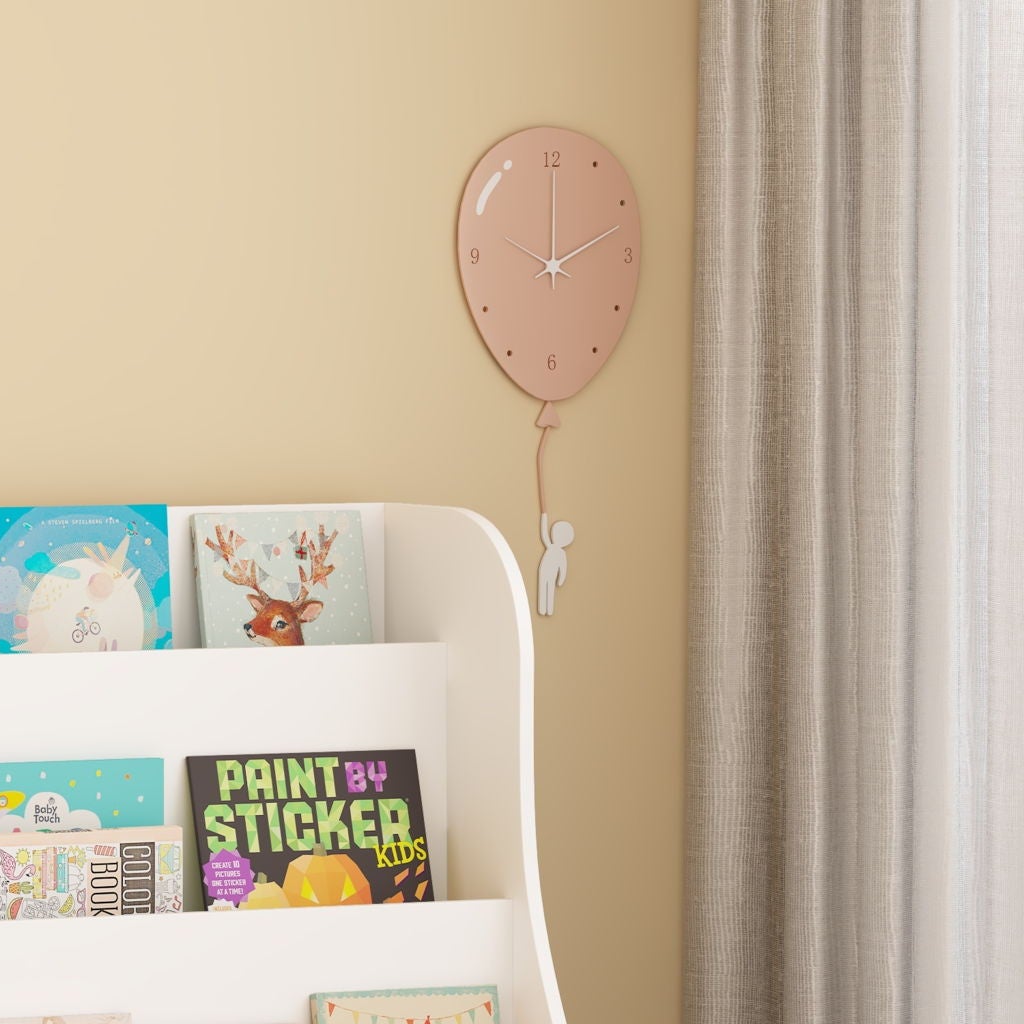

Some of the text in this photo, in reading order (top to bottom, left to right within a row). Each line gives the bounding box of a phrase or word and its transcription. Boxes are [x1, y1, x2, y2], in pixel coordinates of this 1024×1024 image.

[543, 151, 561, 168] 12
[470, 248, 480, 265] 9
[624, 247, 633, 264] 3
[547, 354, 557, 371] 6
[216, 757, 388, 801] PAINT BY
[34, 804, 58, 815] Baby
[33, 813, 61, 824] Touch
[204, 798, 413, 854] STICKER
[373, 836, 427, 869] KIDS
[232, 860, 240, 868] 10
[215, 870, 241, 878] PICTURES
[90, 862, 119, 917] BOOK
[224, 879, 247, 887] STICKER
